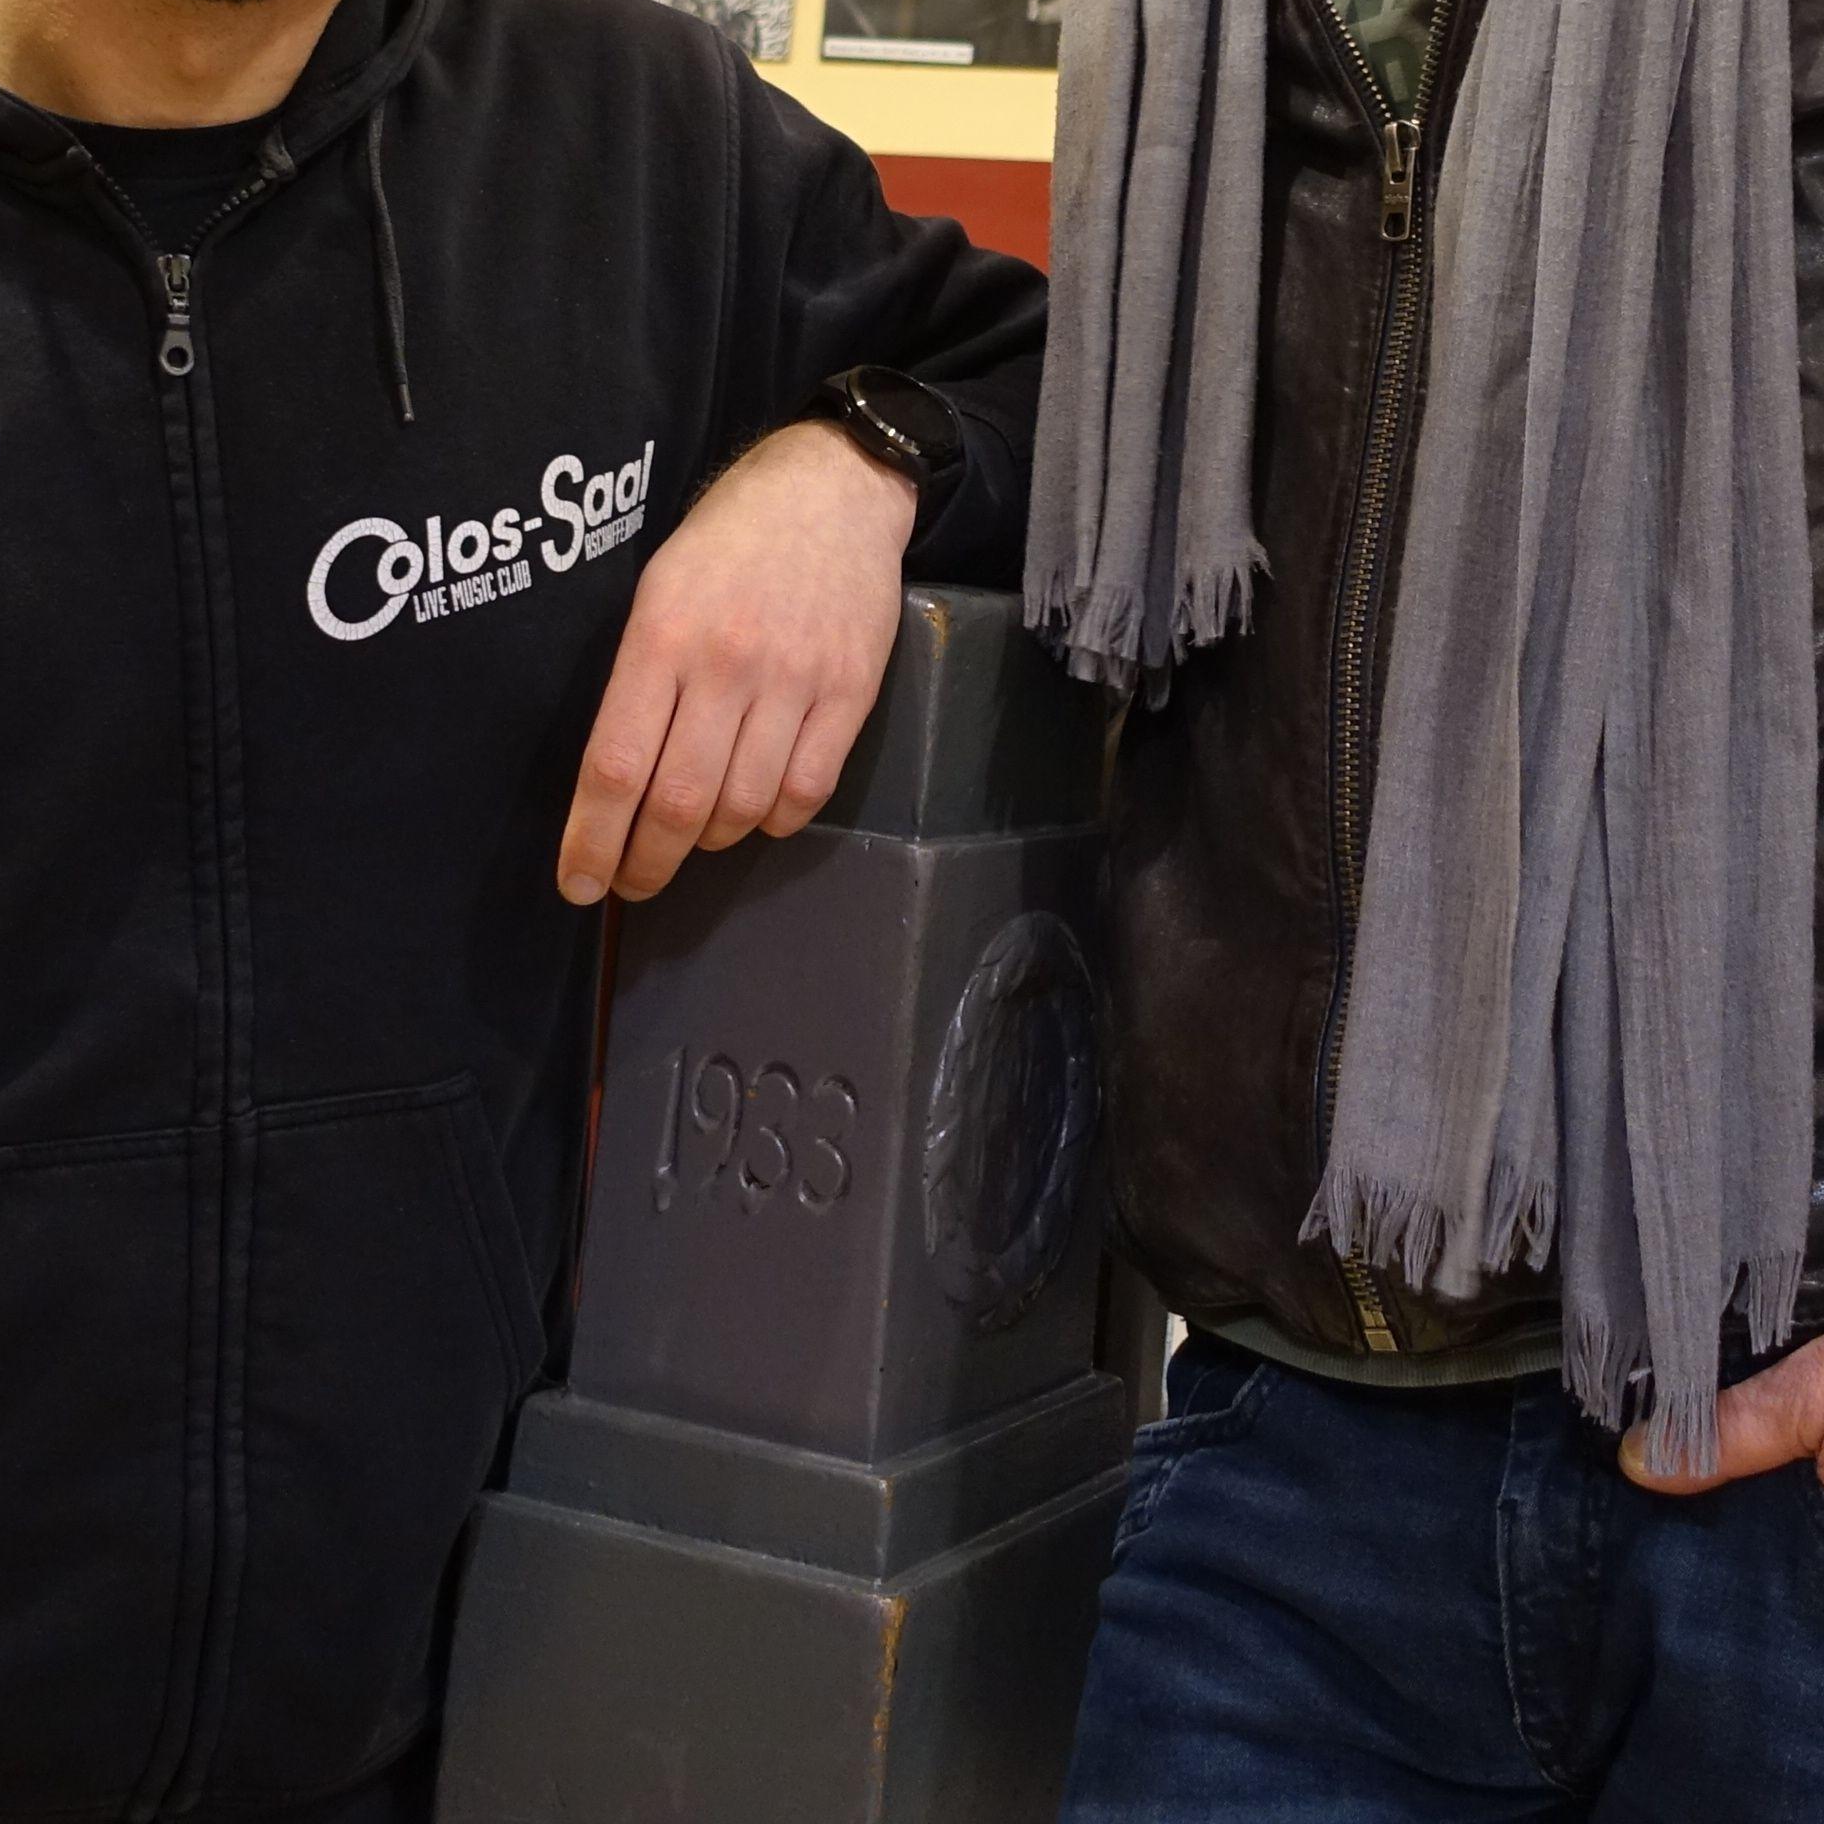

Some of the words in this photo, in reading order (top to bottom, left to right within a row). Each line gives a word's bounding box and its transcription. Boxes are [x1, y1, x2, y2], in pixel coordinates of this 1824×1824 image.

[306, 439, 656, 643] Colos-Saal
[412, 583, 451, 625] LIVE
[452, 572, 497, 614] MUSIC
[497, 560, 533, 603] CLUB
